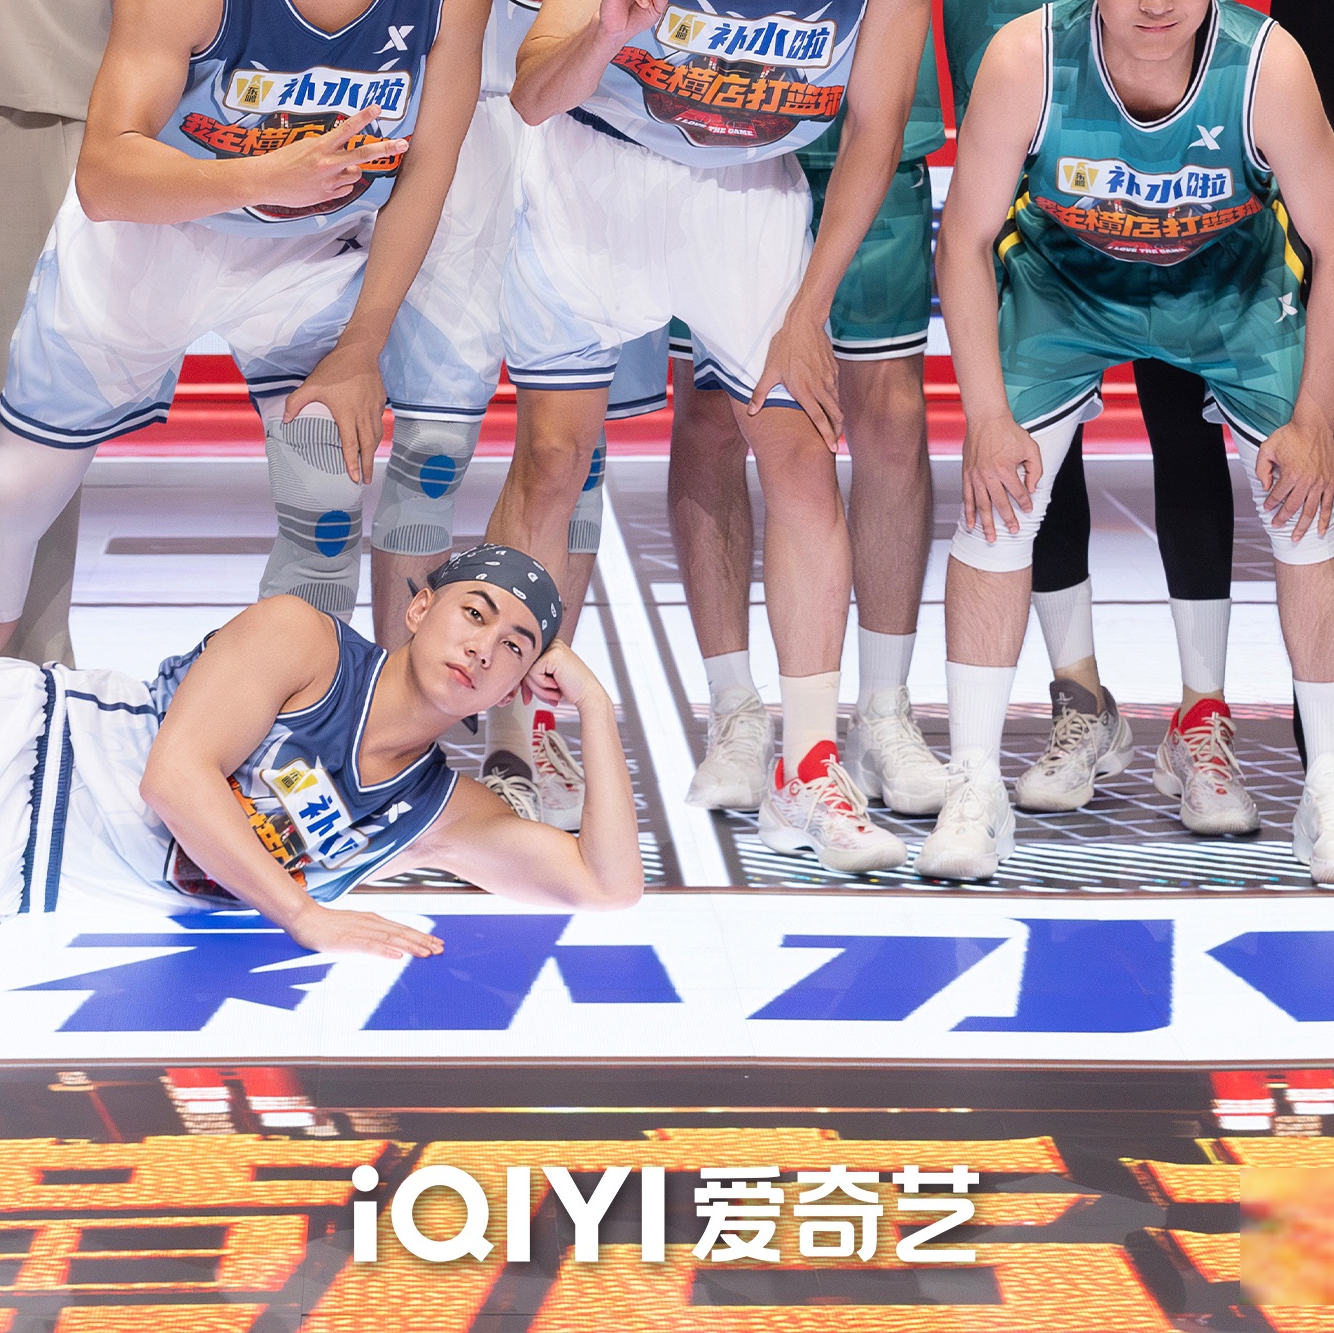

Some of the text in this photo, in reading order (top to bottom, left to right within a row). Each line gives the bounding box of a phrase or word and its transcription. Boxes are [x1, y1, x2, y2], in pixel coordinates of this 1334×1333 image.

[707, 22, 830, 61] 补水啦
[277, 72, 406, 113] 补水啦
[612, 45, 845, 117] 我在横店打篮球
[708, 125, 727, 136] THE
[728, 127, 754, 137] GAME
[1105, 165, 1228, 204] 补水啦
[1138, 247, 1159, 255] THE
[1159, 246, 1187, 254] GAME
